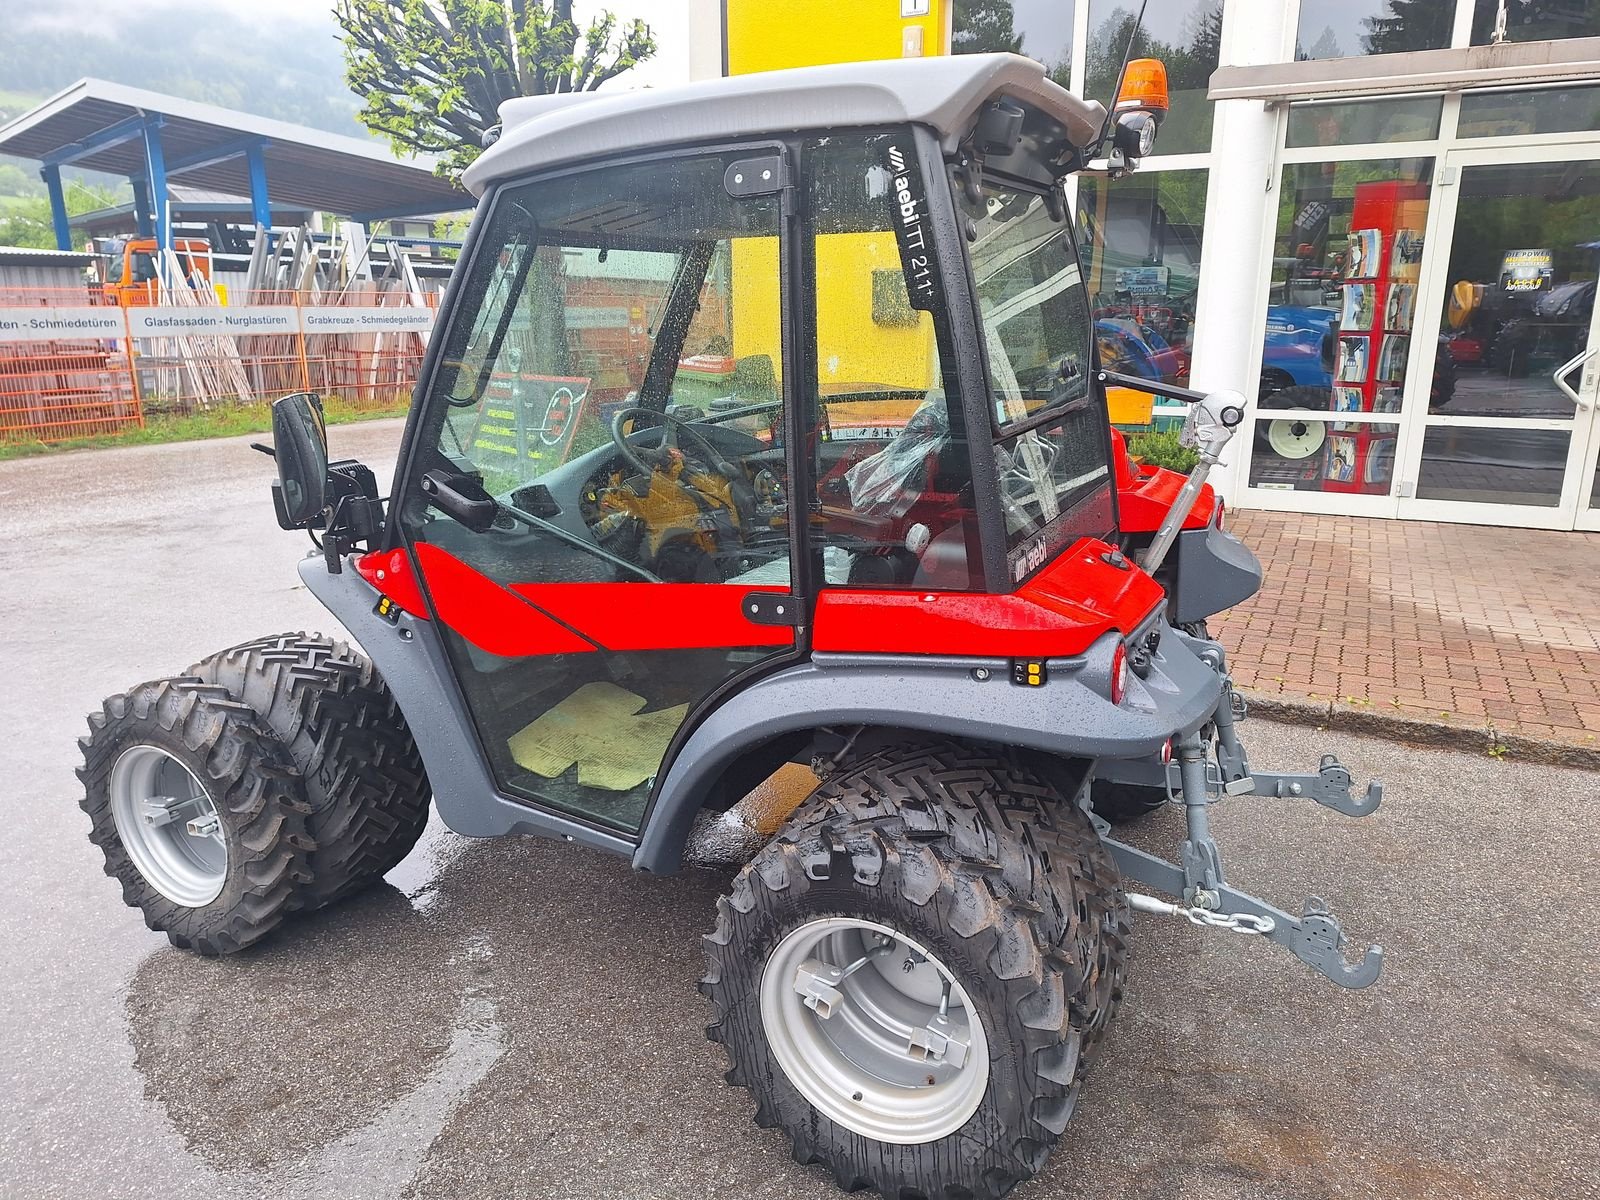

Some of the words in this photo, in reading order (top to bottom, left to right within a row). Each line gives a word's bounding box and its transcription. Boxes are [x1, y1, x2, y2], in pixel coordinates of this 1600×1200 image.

[894, 176, 920, 225] aebi
[30, 318, 118, 329] Schmiedetüren
[144, 316, 217, 327] Glasfassaden
[225, 315, 288, 327] Nurglastüren
[307, 315, 355, 325] Grabkreuze
[361, 315, 430, 326] Schmiedegeländer
[1028, 535, 1047, 571] aebi
